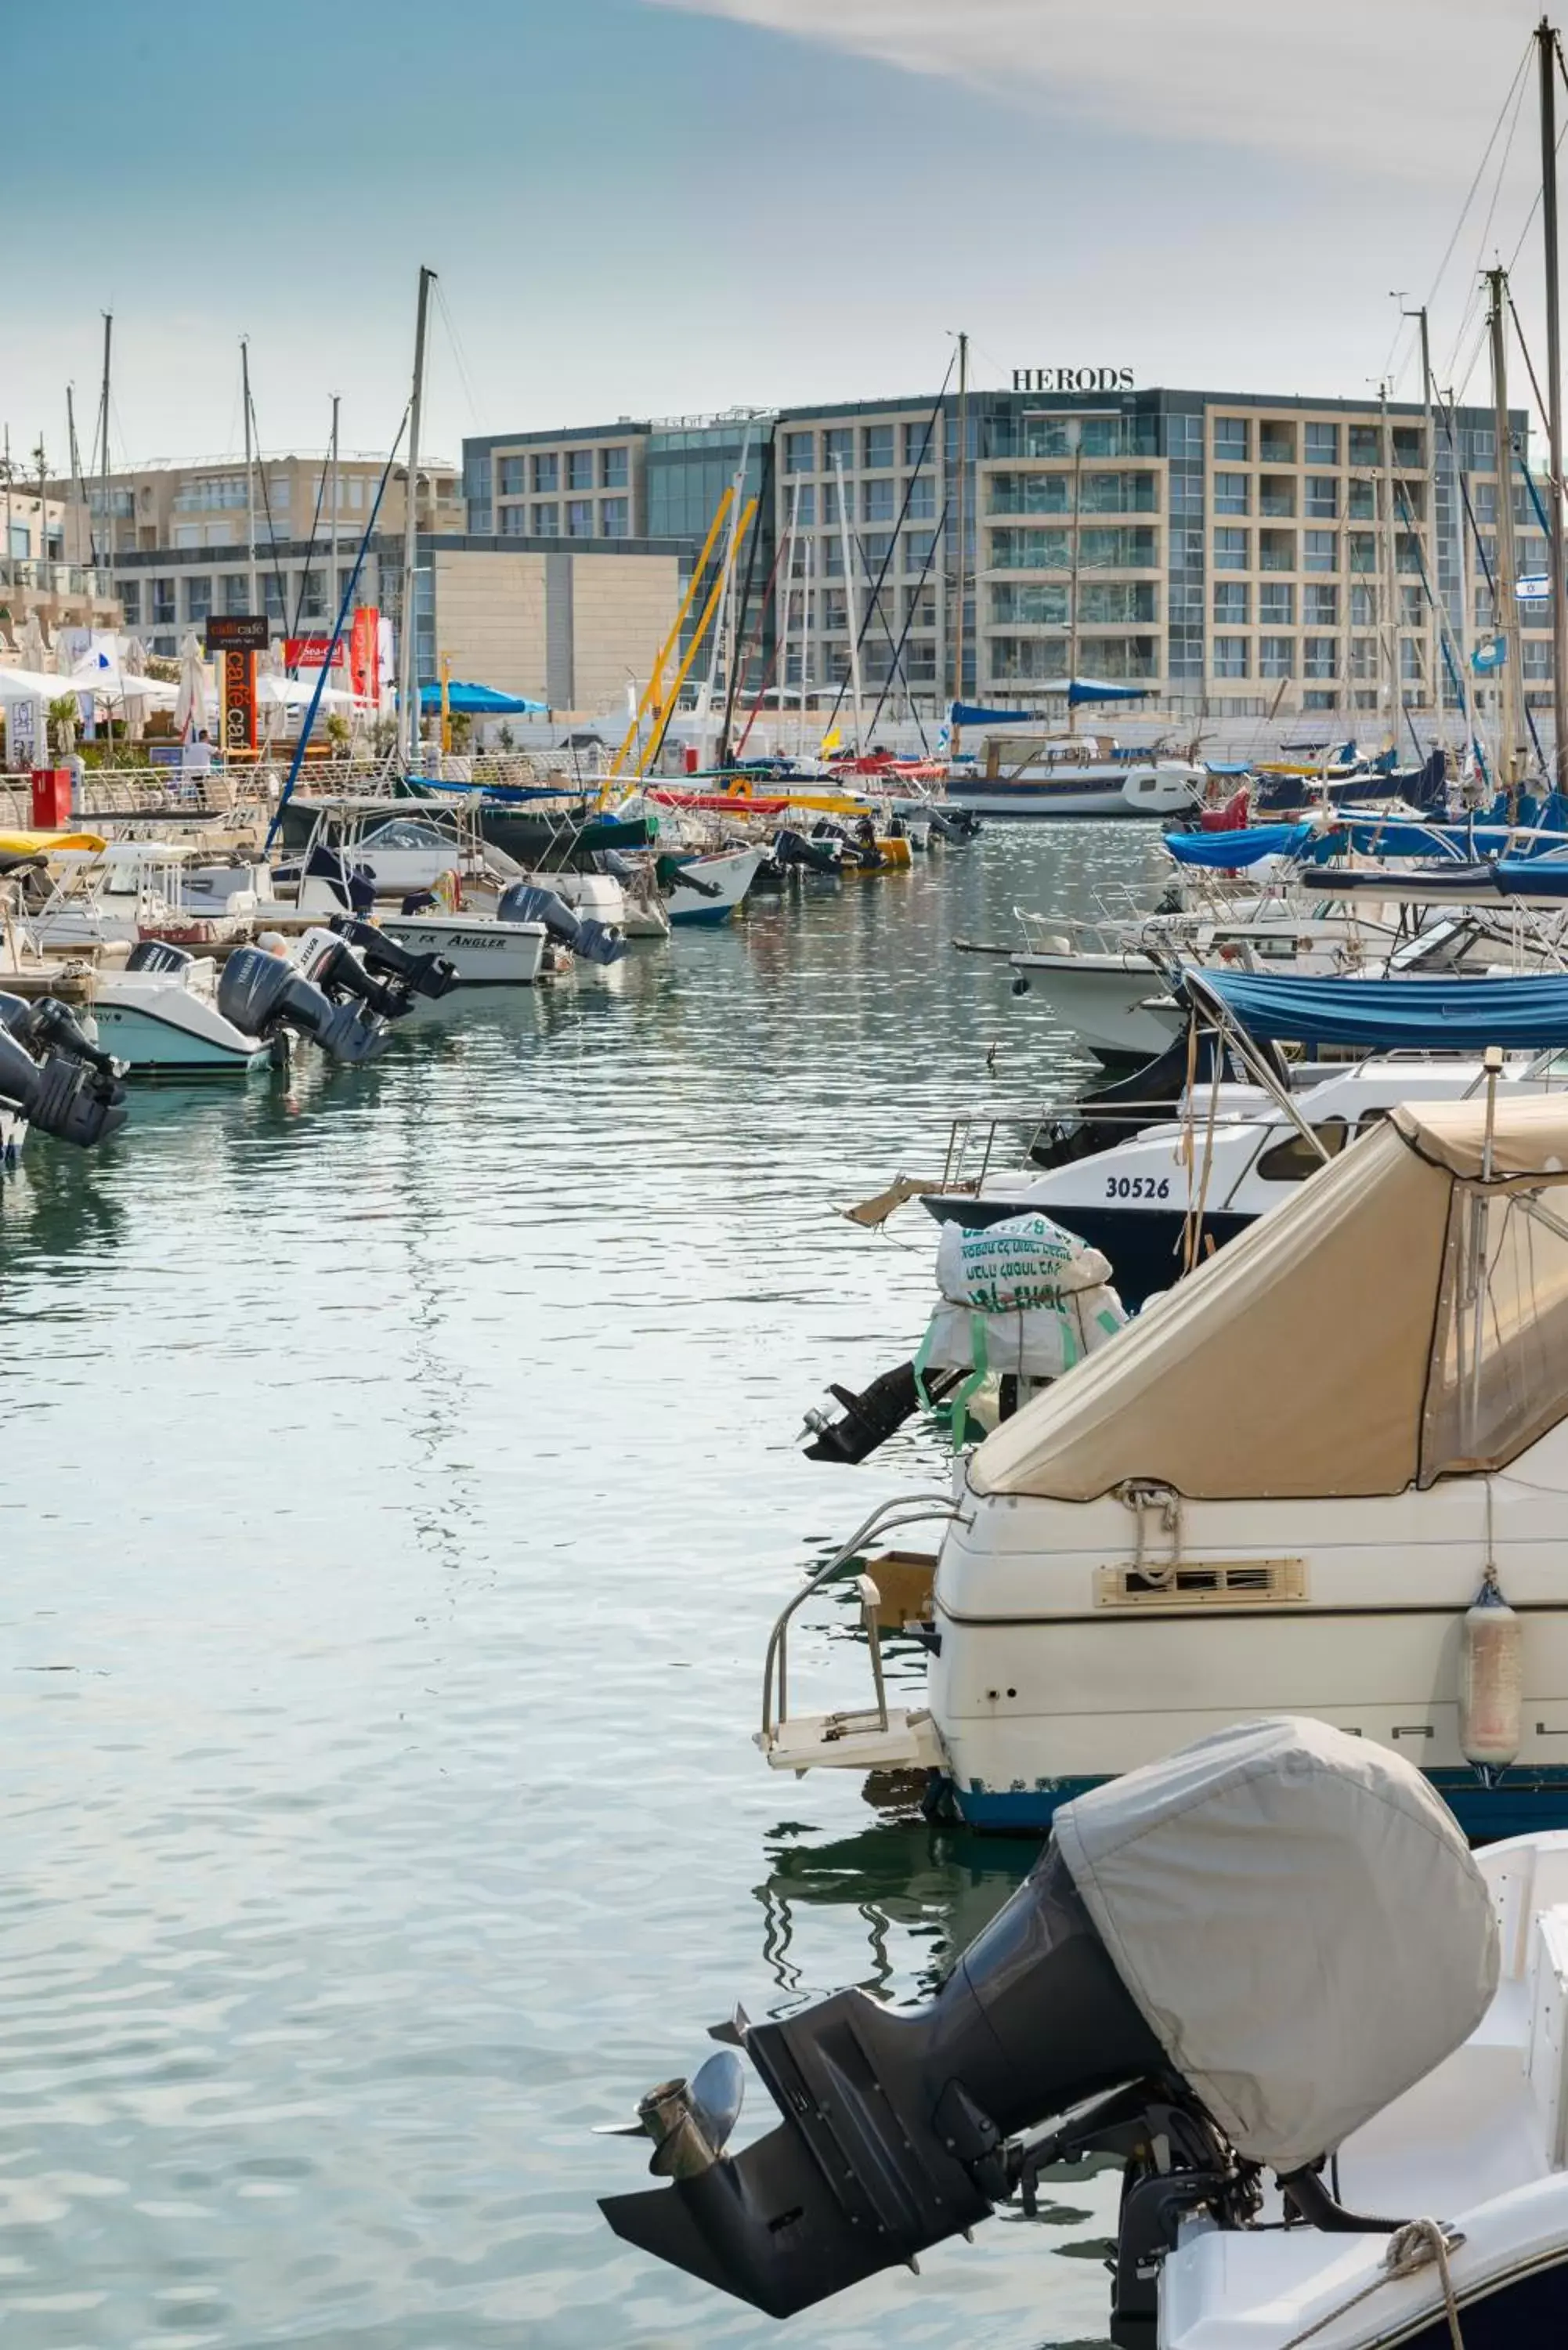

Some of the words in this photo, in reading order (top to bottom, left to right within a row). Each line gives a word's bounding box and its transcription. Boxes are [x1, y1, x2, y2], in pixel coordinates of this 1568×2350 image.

[1013, 368, 1134, 391] HERODS
[1106, 1177, 1169, 1198] 30526
[966, 1264, 997, 1280] חברה
[1000, 1261, 1037, 1281] למסחר
